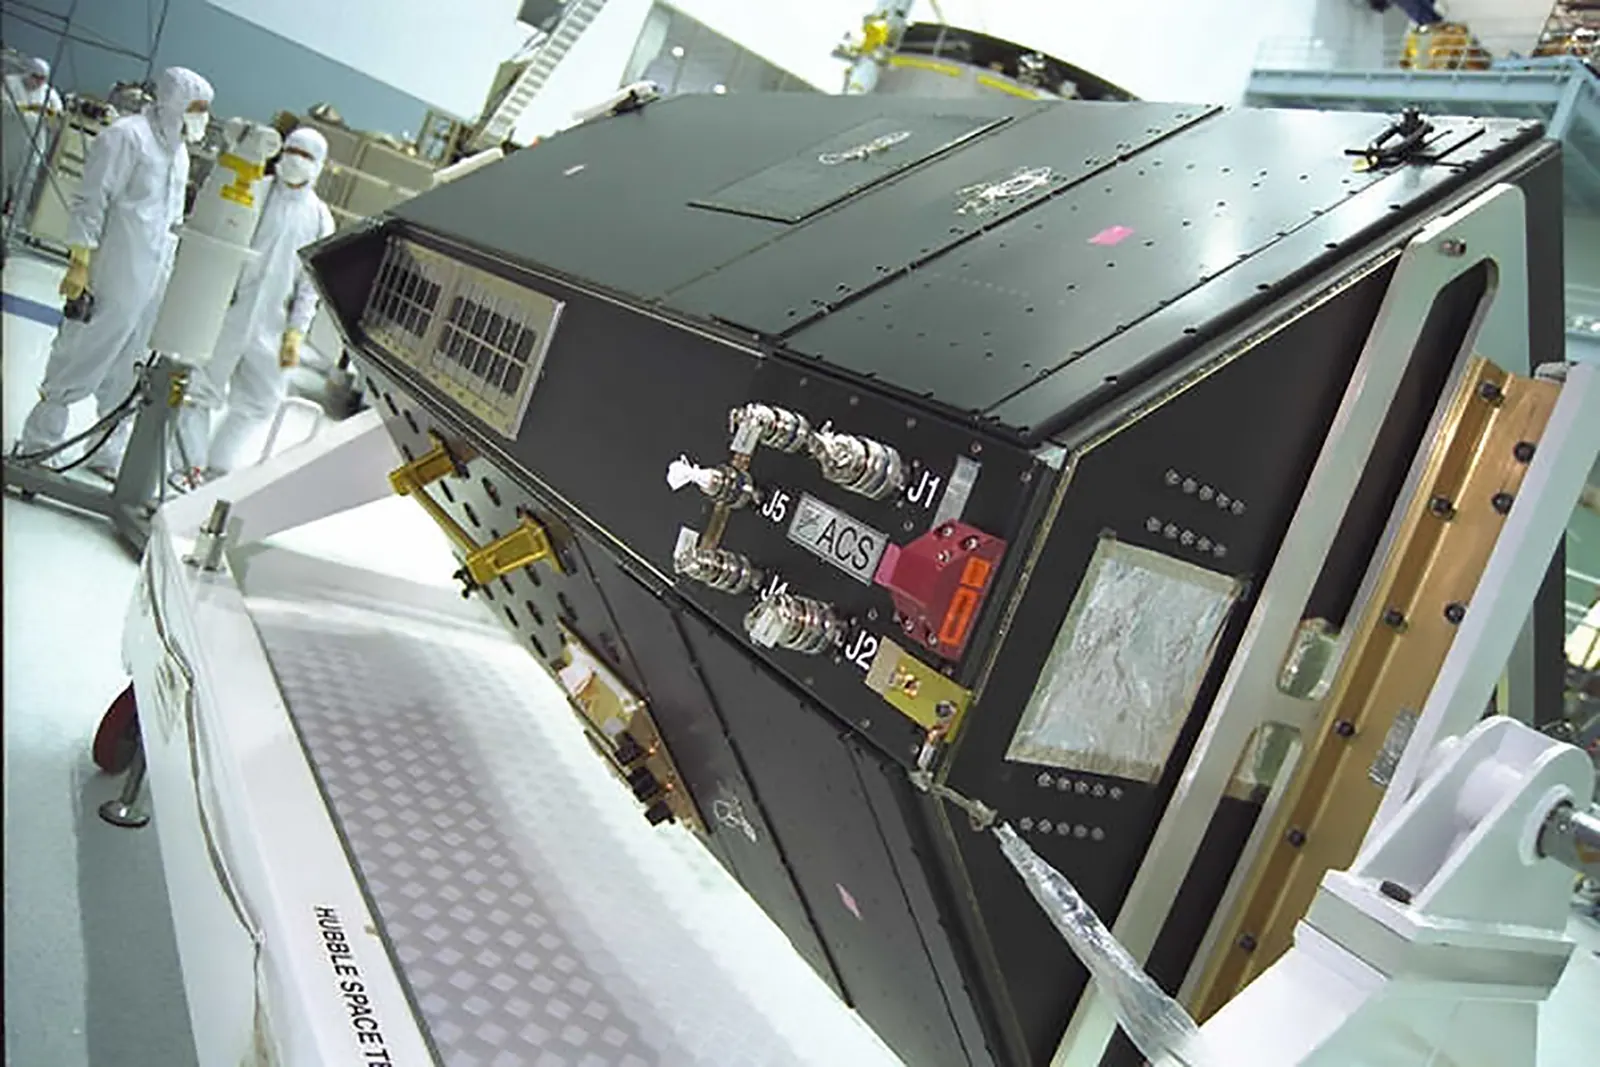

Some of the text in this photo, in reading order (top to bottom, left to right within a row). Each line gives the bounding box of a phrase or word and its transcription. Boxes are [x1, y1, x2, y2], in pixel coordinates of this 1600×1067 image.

[761, 490, 790, 522] J5
[907, 472, 940, 508] J1
[815, 518, 875, 571] ACS
[845, 631, 878, 669] J2
[314, 905, 359, 977] HUBBLE
[340, 980, 384, 1045] SPACE
